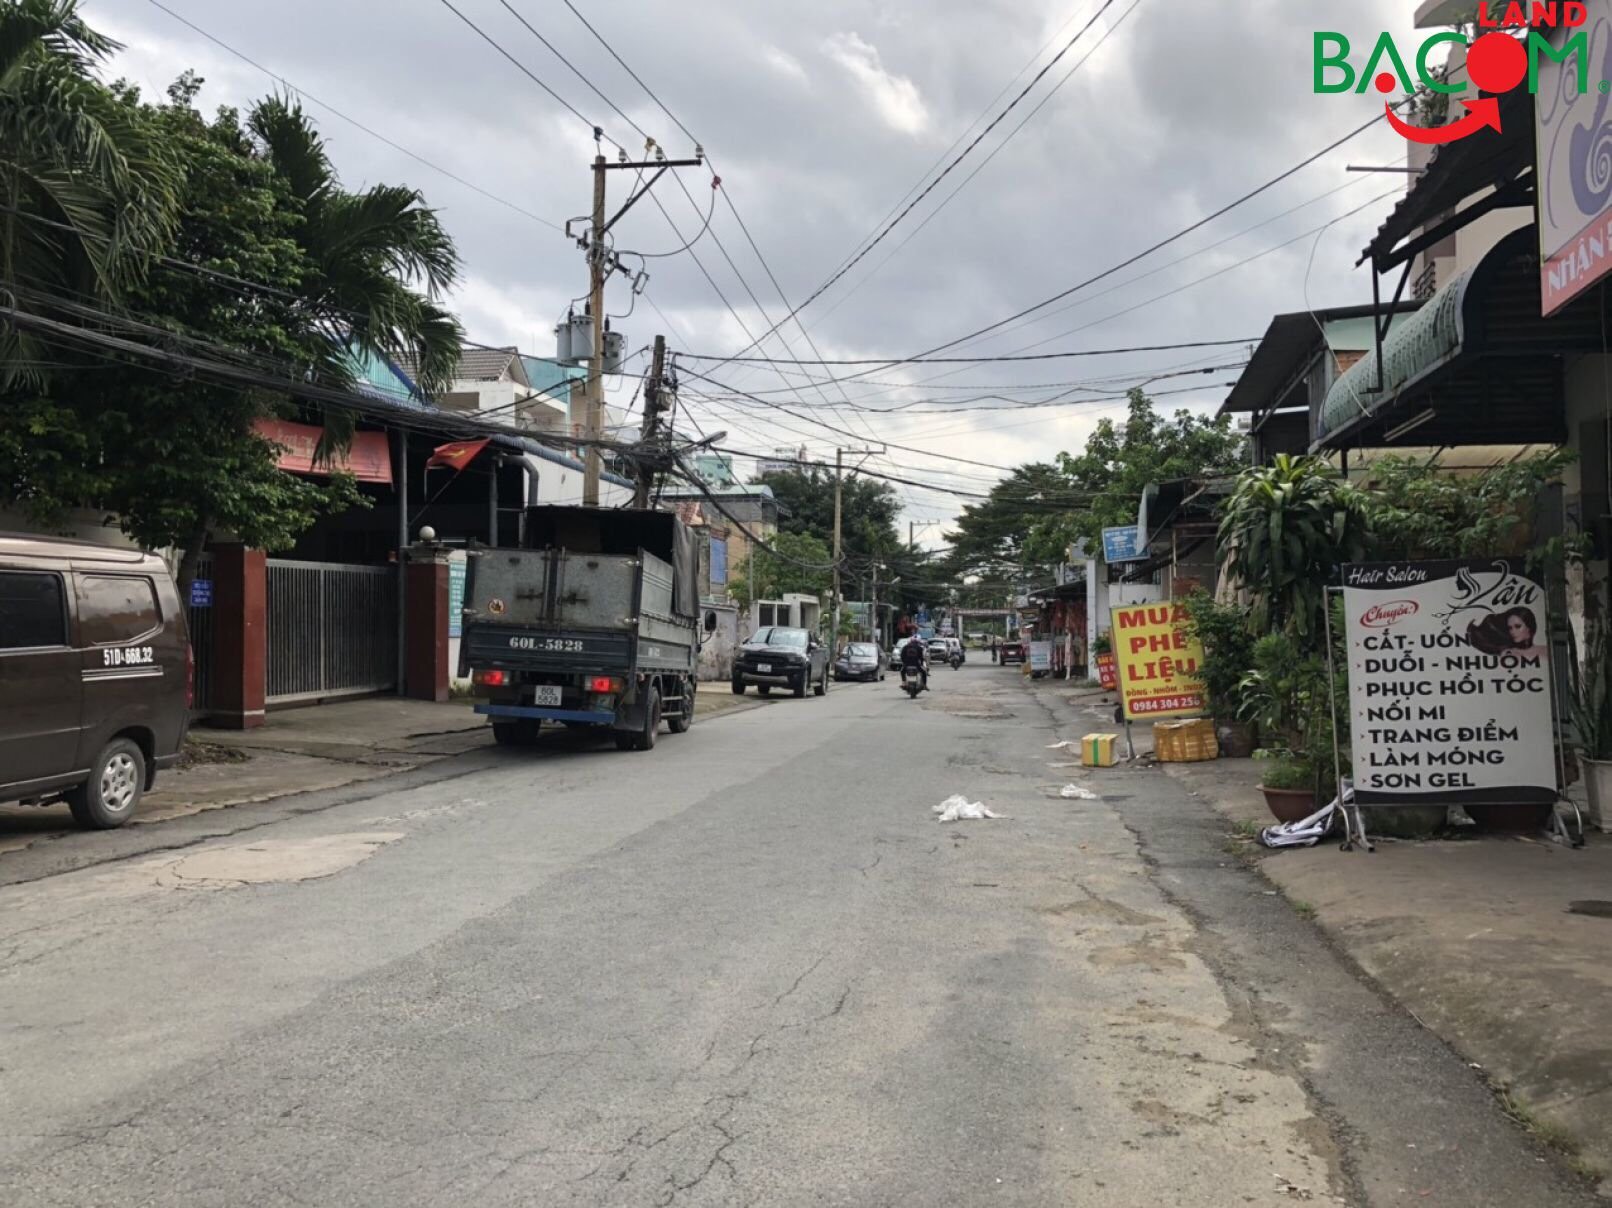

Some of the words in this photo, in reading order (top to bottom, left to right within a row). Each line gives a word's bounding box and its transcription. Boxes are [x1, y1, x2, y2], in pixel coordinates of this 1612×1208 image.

[1547, 224, 1605, 297] NHẬN
[1348, 567, 1384, 584] Hair
[1386, 566, 1427, 582] Salon
[1118, 604, 1191, 629] MUA
[509, 636, 584, 651] 60L-5828
[1421, 626, 1471, 649] UỐN
[1446, 650, 1541, 673] NHUỘM
[541, 687, 557, 696] 60L
[1366, 681, 1432, 700] PHỤC
[1439, 672, 1484, 695] HỒI
[1491, 675, 1544, 693] TÓC
[538, 695, 559, 704] 5828
[1132, 700, 1158, 711] 0984
[1160, 698, 1179, 709] 304
[1367, 699, 1411, 721] NỐI
[1419, 705, 1445, 720] MI
[1367, 727, 1451, 744] TRANG
[1457, 718, 1519, 743] ĐIỂM
[1369, 748, 1420, 767] LÀM
[1427, 746, 1505, 767] MÓNG
[1370, 773, 1421, 788] SƠN
[1428, 772, 1475, 787] GEL
